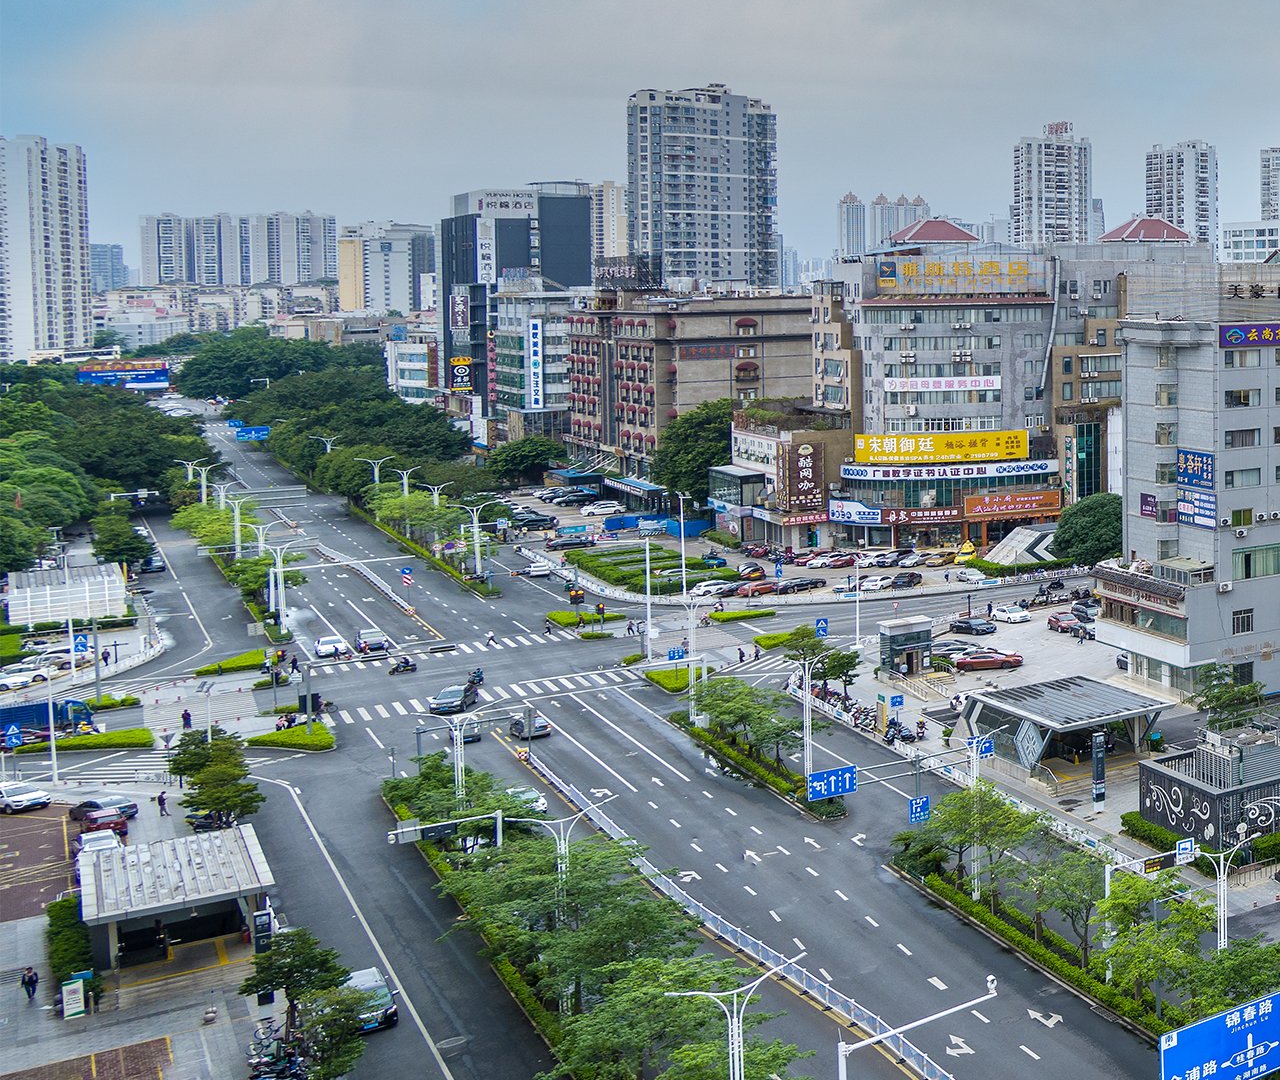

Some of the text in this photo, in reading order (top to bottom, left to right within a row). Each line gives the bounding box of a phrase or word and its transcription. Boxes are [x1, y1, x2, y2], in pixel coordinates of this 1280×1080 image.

[902, 260, 1028, 276] 雅斯特酒店
[903, 277, 1025, 286] YESTE HOTEL
[868, 437, 935, 453] 宋朝御廷
[873, 467, 987, 478] 广西数字证书认证中心
[1225, 999, 1273, 1028] 锦春路
[1231, 1020, 1257, 1033] Jinchun
[1235, 1046, 1265, 1063] 桂春路
[1234, 1064, 1267, 1080] 金湖南路
